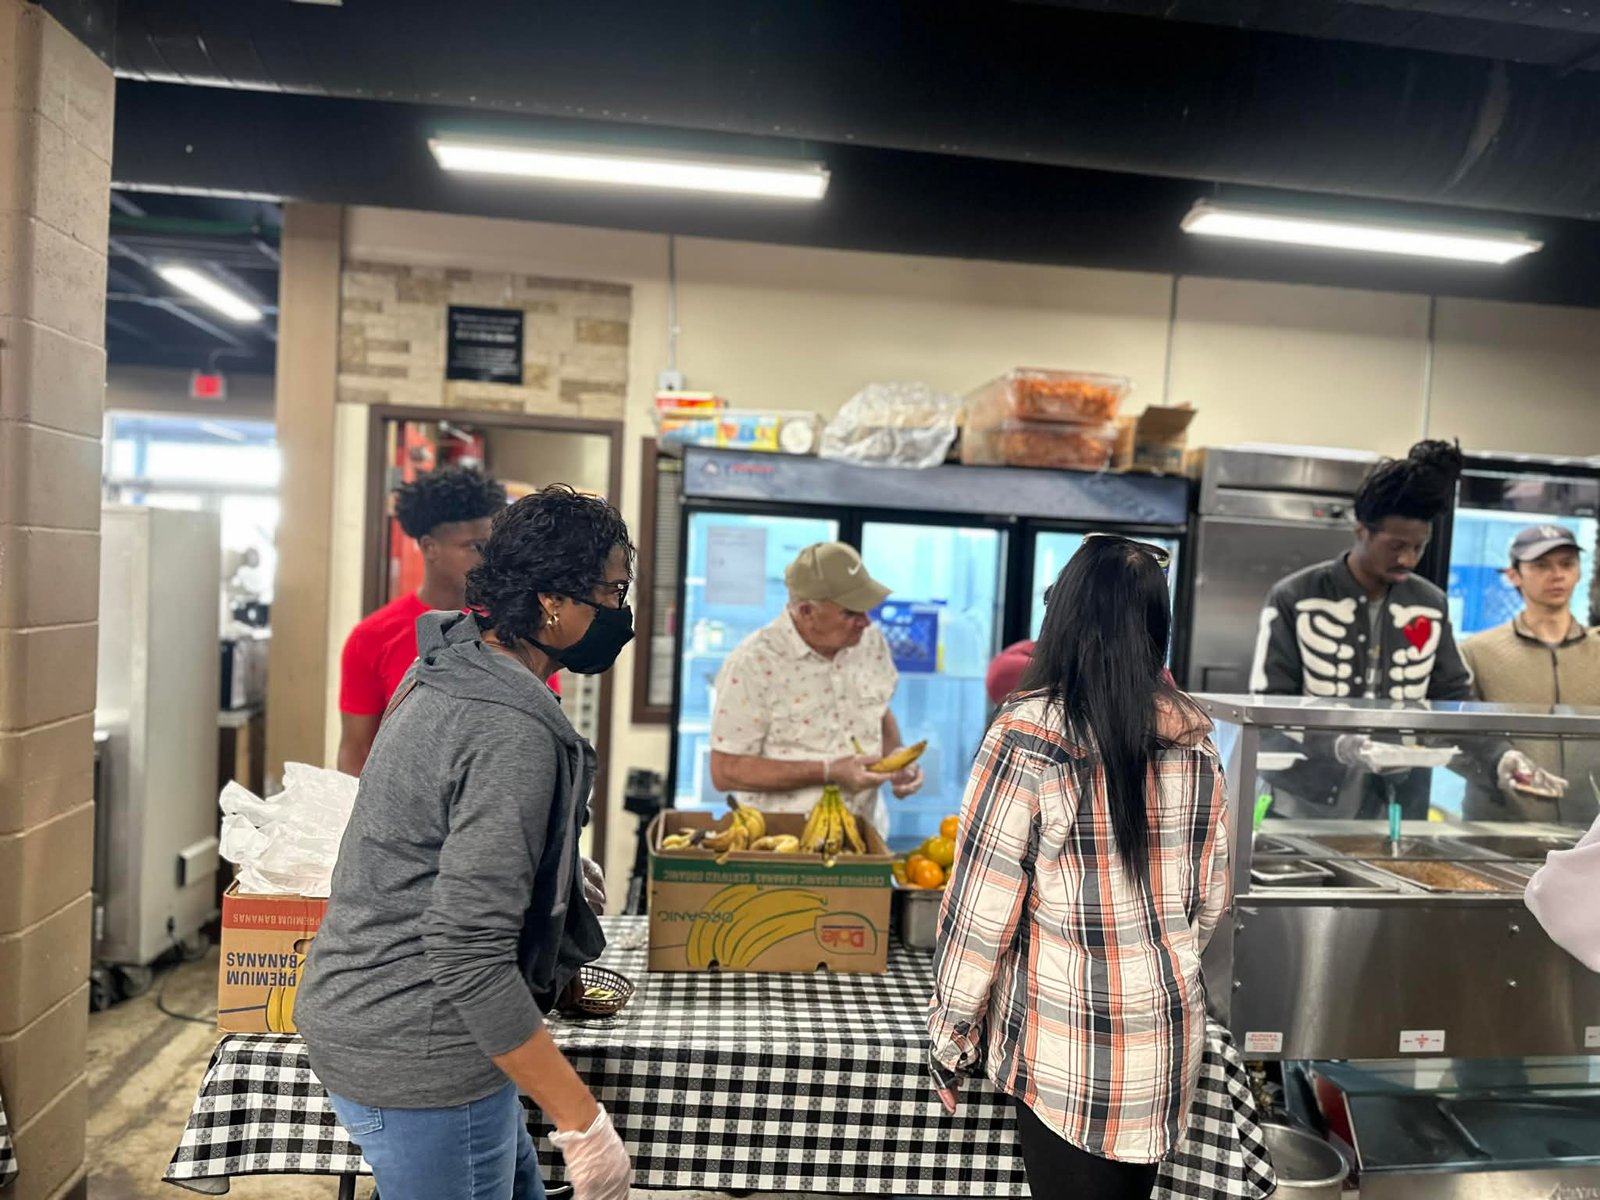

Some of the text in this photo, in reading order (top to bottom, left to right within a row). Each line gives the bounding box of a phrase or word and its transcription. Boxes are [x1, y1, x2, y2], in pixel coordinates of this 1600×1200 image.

[663, 870, 884, 887] CERTIFIED ORGANIC BANANAS CERTIFIED ORGANIC
[232, 913, 321, 926] PREMIUM BANANAS
[657, 910, 734, 923] ORGANIC
[821, 928, 864, 948] Dole
[226, 952, 298, 969] BANANAS
[226, 970, 296, 987] PREMIUM
